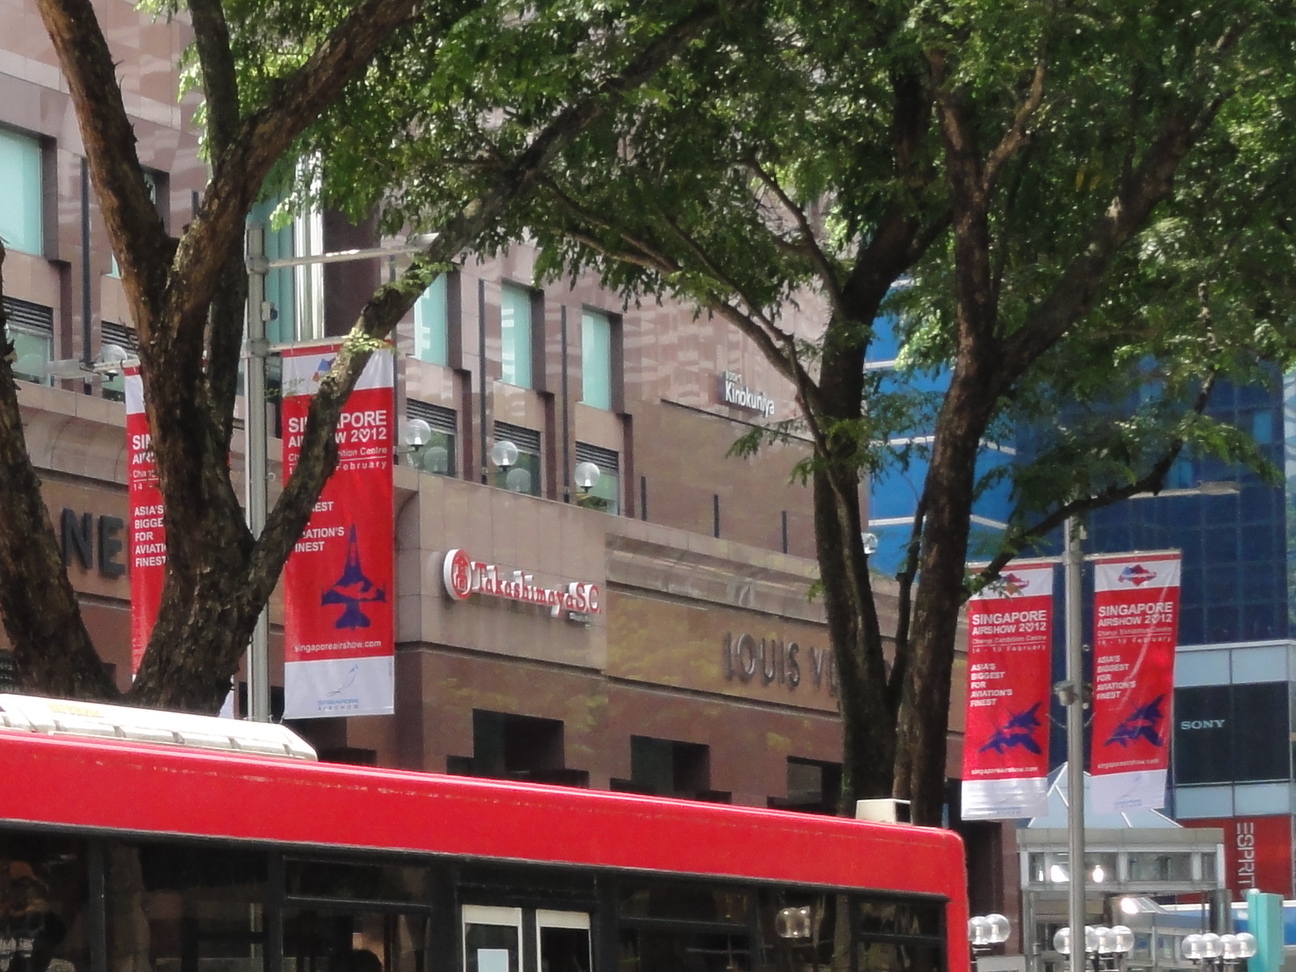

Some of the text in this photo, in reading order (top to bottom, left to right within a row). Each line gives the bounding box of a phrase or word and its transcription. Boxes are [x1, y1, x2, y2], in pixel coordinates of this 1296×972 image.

[725, 380, 775, 418] Kinokuniya
[288, 410, 387, 433] SIPORE
[134, 505, 164, 516] ASIA'S
[134, 518, 164, 529] BIGGE
[135, 531, 154, 542] FOR
[304, 526, 345, 539] ATION'S
[135, 543, 166, 555] AVIATI
[295, 541, 325, 552] INEST
[135, 556, 166, 567] FINEST
[471, 561, 576, 618] Takashimaya
[1098, 602, 1173, 617] SINGAPORE
[972, 610, 1047, 625] SINGAPORE
[1098, 616, 1142, 627] AIRSHOW
[972, 624, 1017, 635] AIRSHOW
[294, 640, 382, 653] singaporeairshow.com
[1098, 655, 1121, 663] ASIA'S
[971, 663, 996, 671] ASIA'S
[1097, 664, 1129, 673] BIGGEST
[971, 672, 1005, 680] BIGGEST
[1097, 674, 1111, 682] FOR
[1097, 681, 1136, 691] AVIATION'S
[971, 689, 1013, 698] AVIATION'S
[1097, 691, 1121, 700] FINEST
[970, 699, 997, 707] FINEST
[1181, 720, 1225, 730] SONY
[971, 766, 1038, 775] singaporeairshow.com
[1236, 822, 1254, 887] ESPRIT
